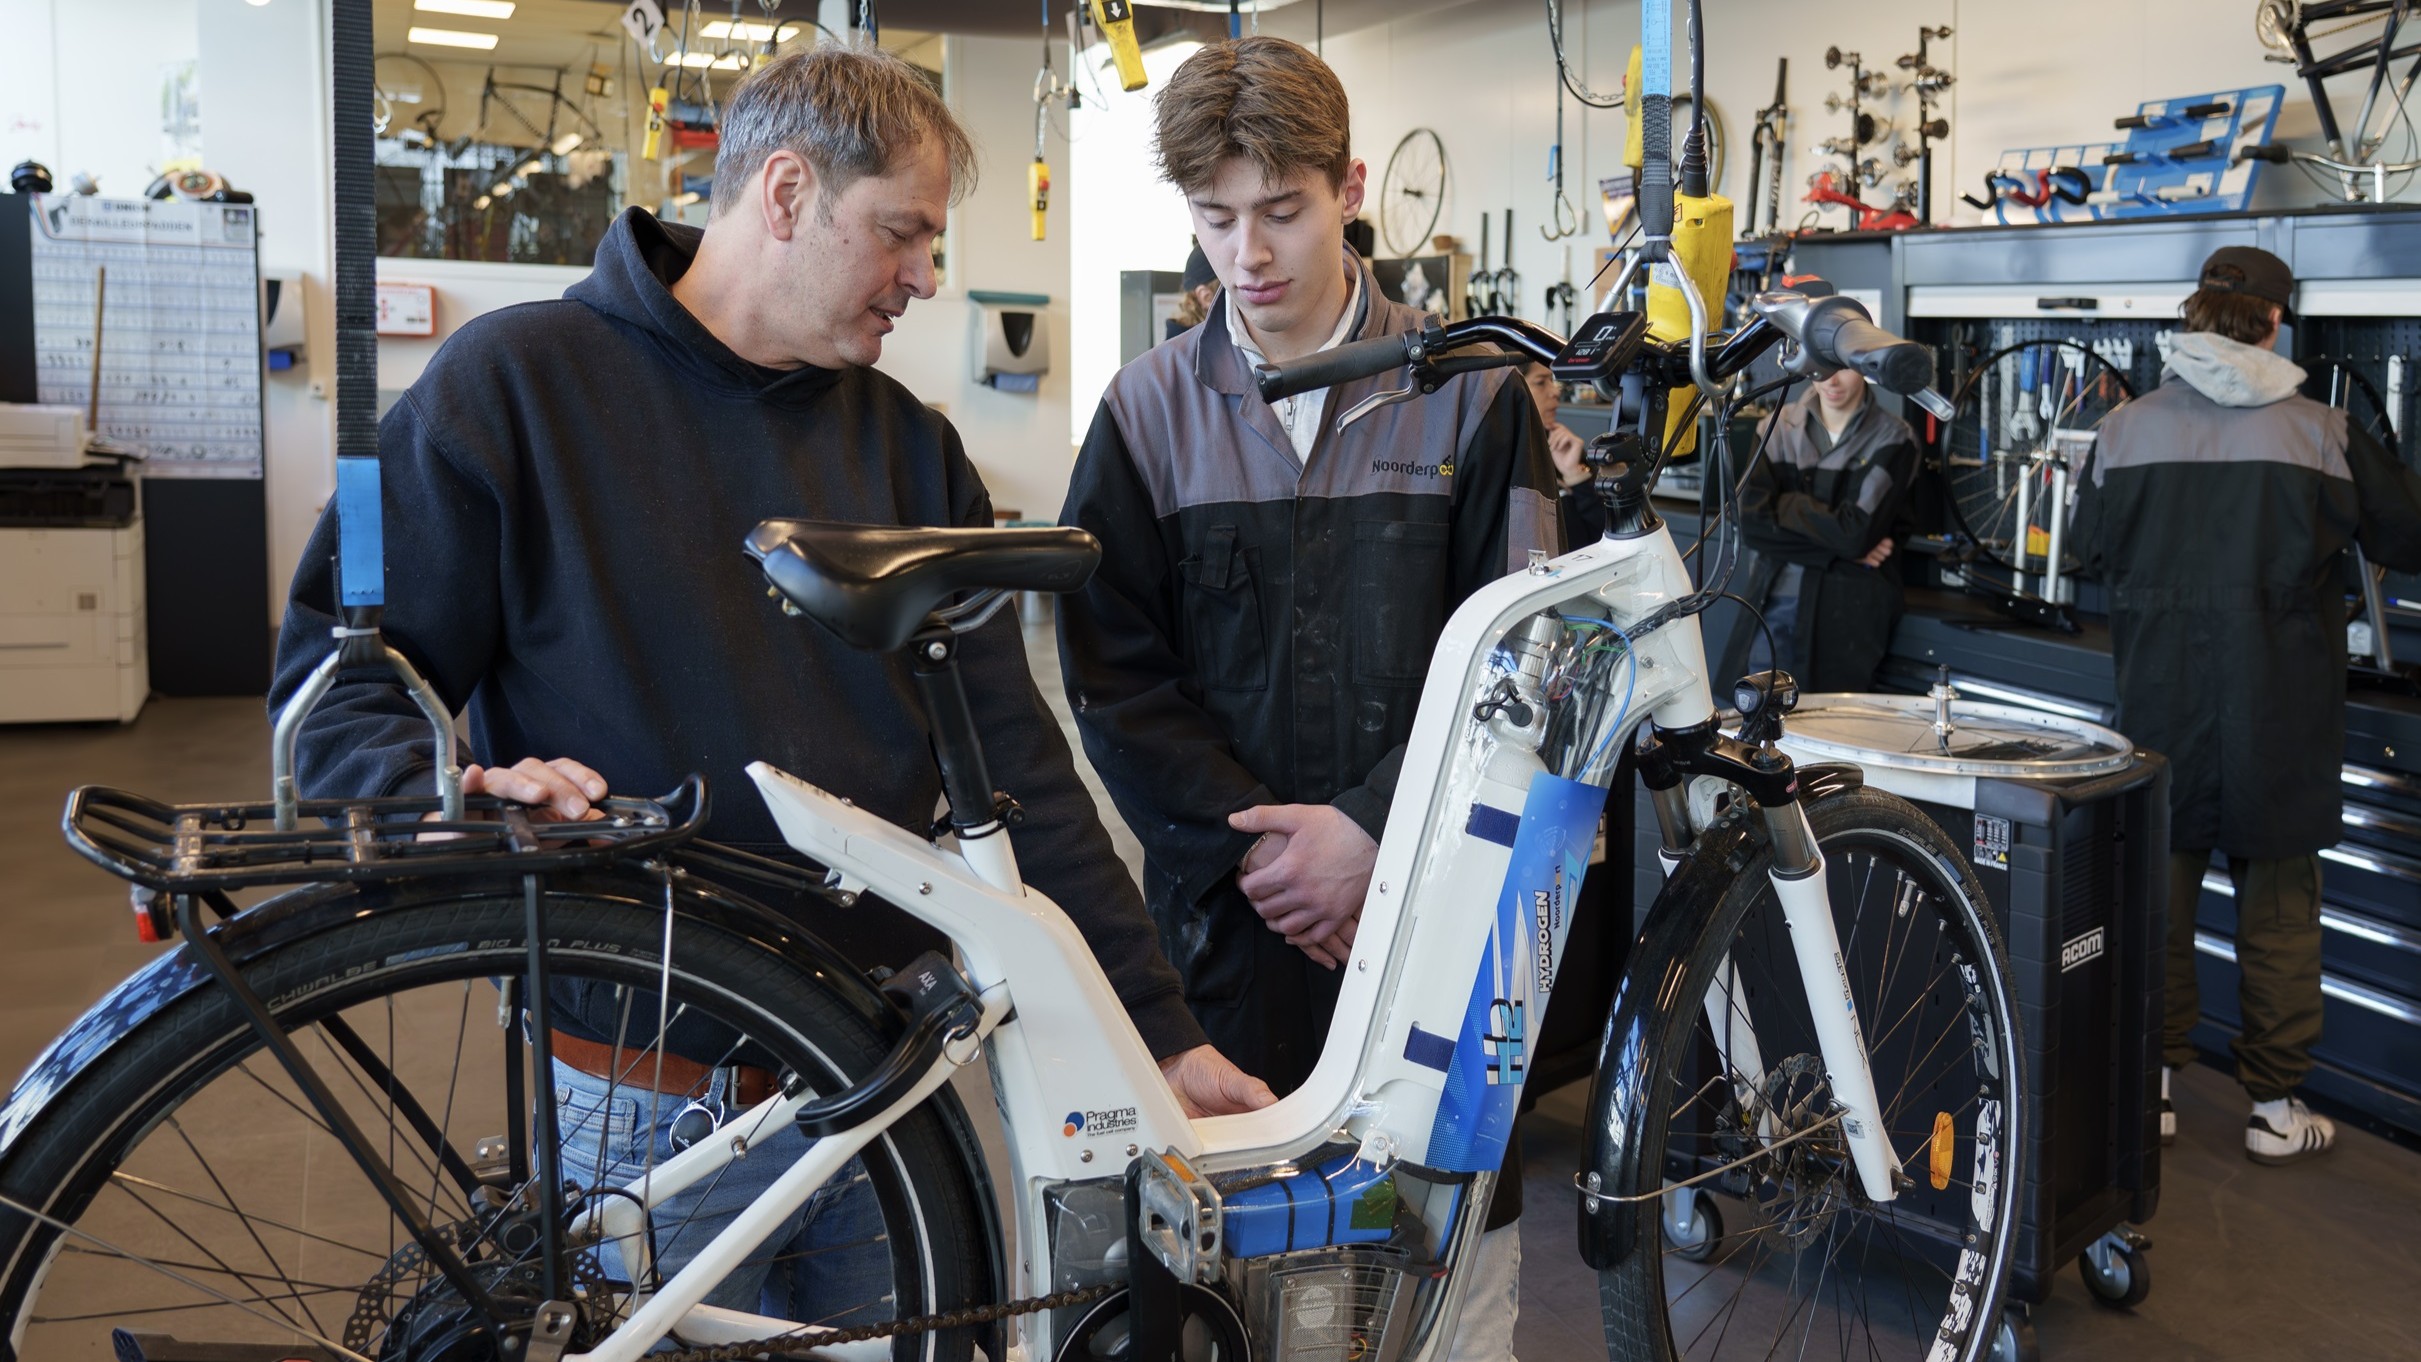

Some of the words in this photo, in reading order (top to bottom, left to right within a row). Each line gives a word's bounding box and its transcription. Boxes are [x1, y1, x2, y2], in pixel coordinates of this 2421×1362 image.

[633, 8, 654, 37] 2
[1372, 459, 1454, 479] Noorderpoo
[1897, 827, 1938, 855] SCHWALBE
[569, 939, 621, 954] PLUS
[1534, 890, 1552, 994] HYDROGEN
[2061, 933, 2101, 967] ACOM
[267, 960, 378, 1009] CHWALBE
[918, 971, 937, 991] AXA
[1086, 1107, 1136, 1122] Pragma
